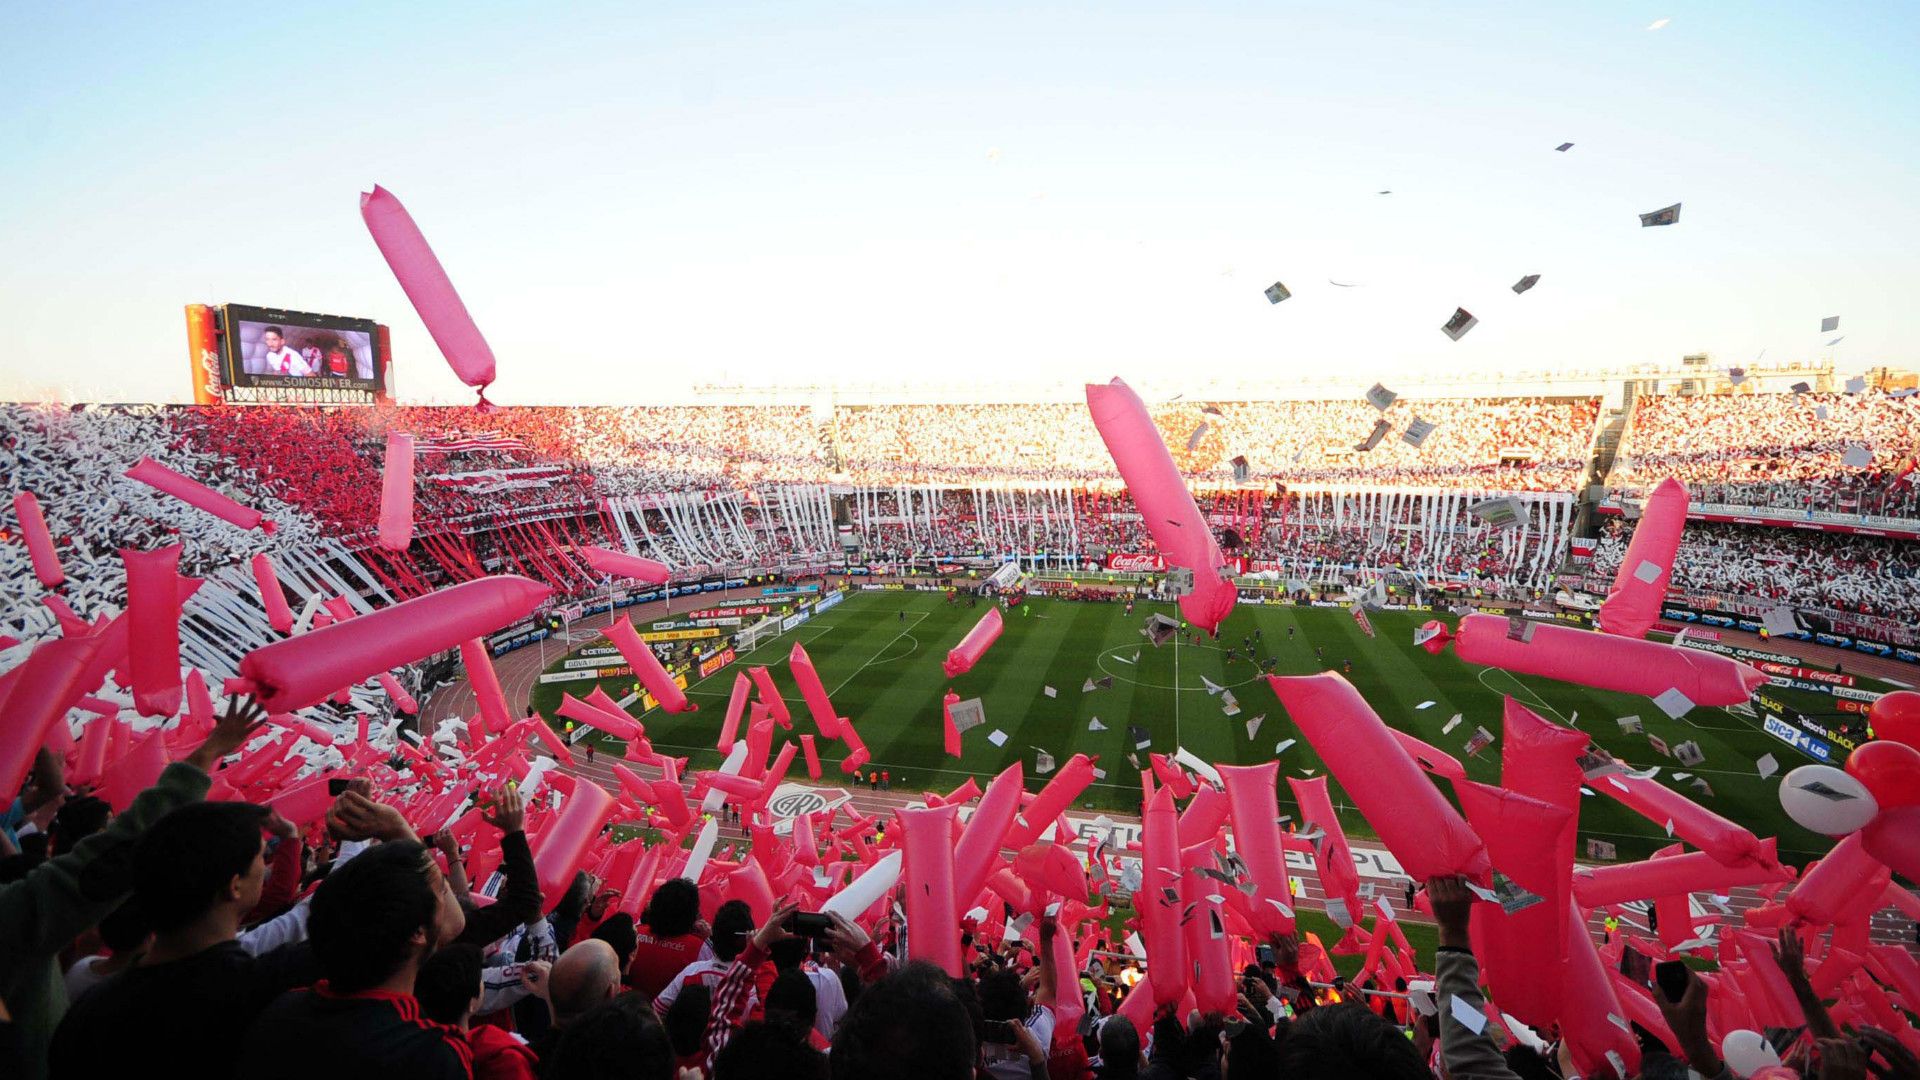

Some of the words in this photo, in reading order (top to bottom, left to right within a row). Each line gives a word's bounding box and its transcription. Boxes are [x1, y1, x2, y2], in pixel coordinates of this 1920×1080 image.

[1522, 609, 1555, 618] Polacrin
[1817, 632, 1848, 642] POWER
[1857, 640, 1889, 650] POWER
[1737, 649, 1800, 665] autocrédito
[1791, 680, 1810, 690] LED
[1760, 695, 1784, 714] BLACK
[1827, 729, 1856, 752] BLACK
[1810, 742, 1828, 758] LED
